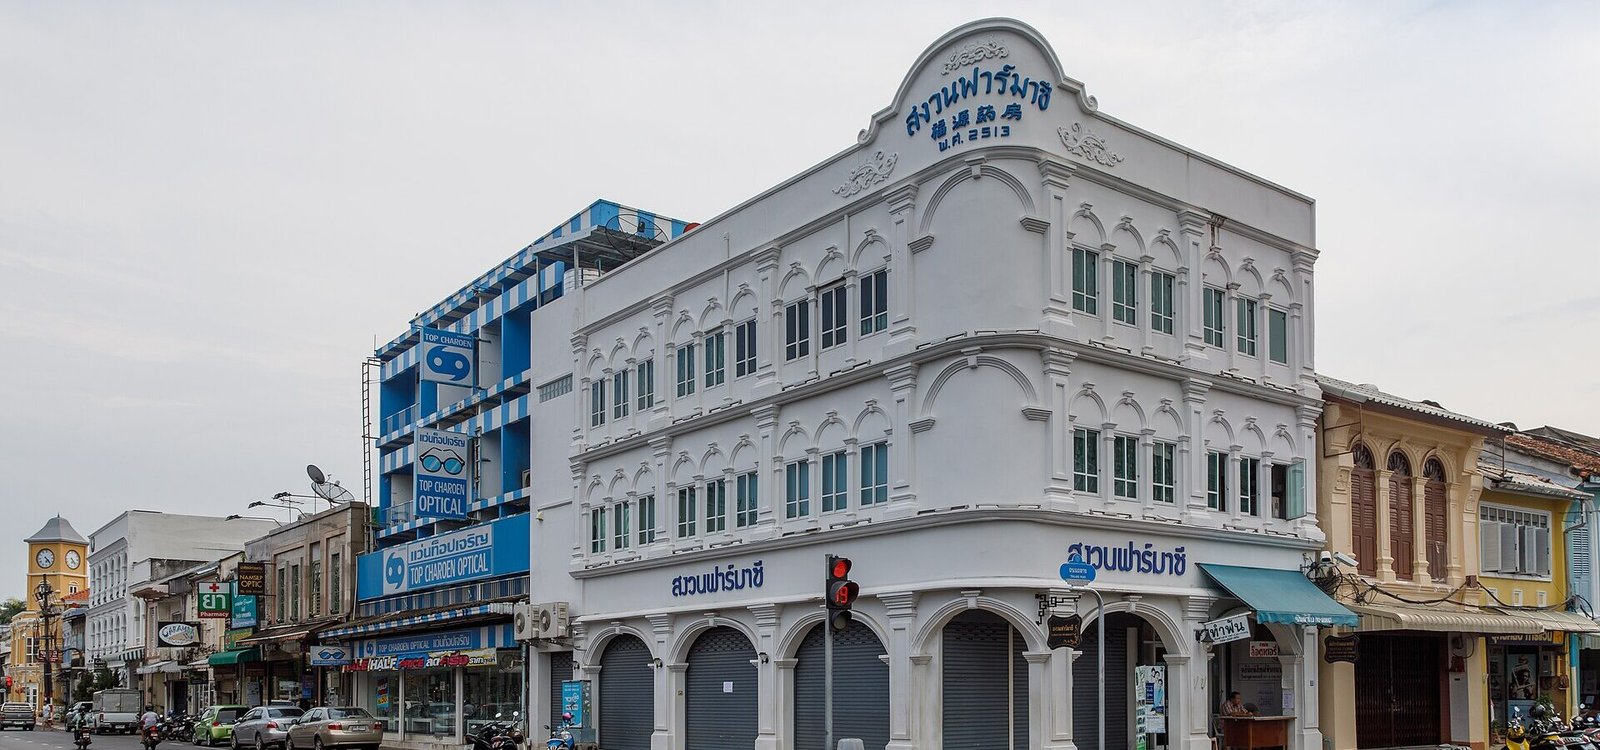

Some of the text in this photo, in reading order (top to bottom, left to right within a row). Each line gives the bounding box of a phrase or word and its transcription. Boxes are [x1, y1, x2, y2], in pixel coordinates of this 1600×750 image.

[905, 63, 1053, 137] สงวนฟาร์มาซี
[938, 125, 1011, 152] พ.ศ. 2513
[424, 333, 438, 342] TOP
[440, 336, 472, 348] CHAROEN
[419, 479, 465, 496] TOP CHAROEN
[418, 494, 465, 515] OPTICAL
[410, 532, 489, 562] แว่นท็อปเจริญ
[410, 552, 489, 585] TOP CHAROEN OPTICAL
[671, 559, 764, 597] สงวนฟาร์มาซี
[240, 580, 263, 588] OPTIC
[202, 594, 226, 609] ยา
[1209, 619, 1246, 638] ทำฟัน
[378, 644, 388, 653] TOP
[388, 641, 410, 652] CHAROEN
[410, 639, 430, 650] OPTICAL
[370, 656, 398, 670] HALF
